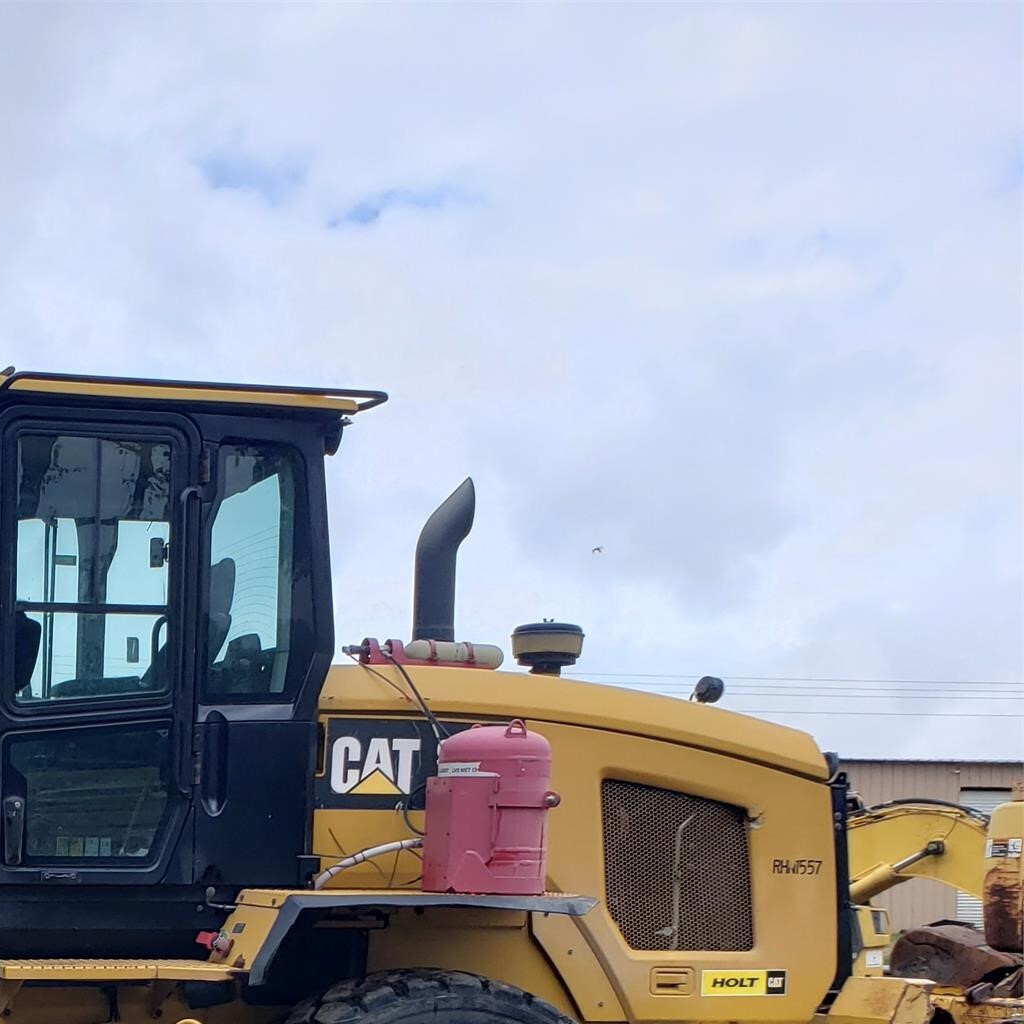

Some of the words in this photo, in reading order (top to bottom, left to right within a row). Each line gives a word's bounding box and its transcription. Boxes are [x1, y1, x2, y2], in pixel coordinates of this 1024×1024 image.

[330, 736, 421, 795] CAT
[772, 859, 823, 875] RHW1557
[711, 977, 760, 988] HOLT
[767, 977, 784, 988] CAT
